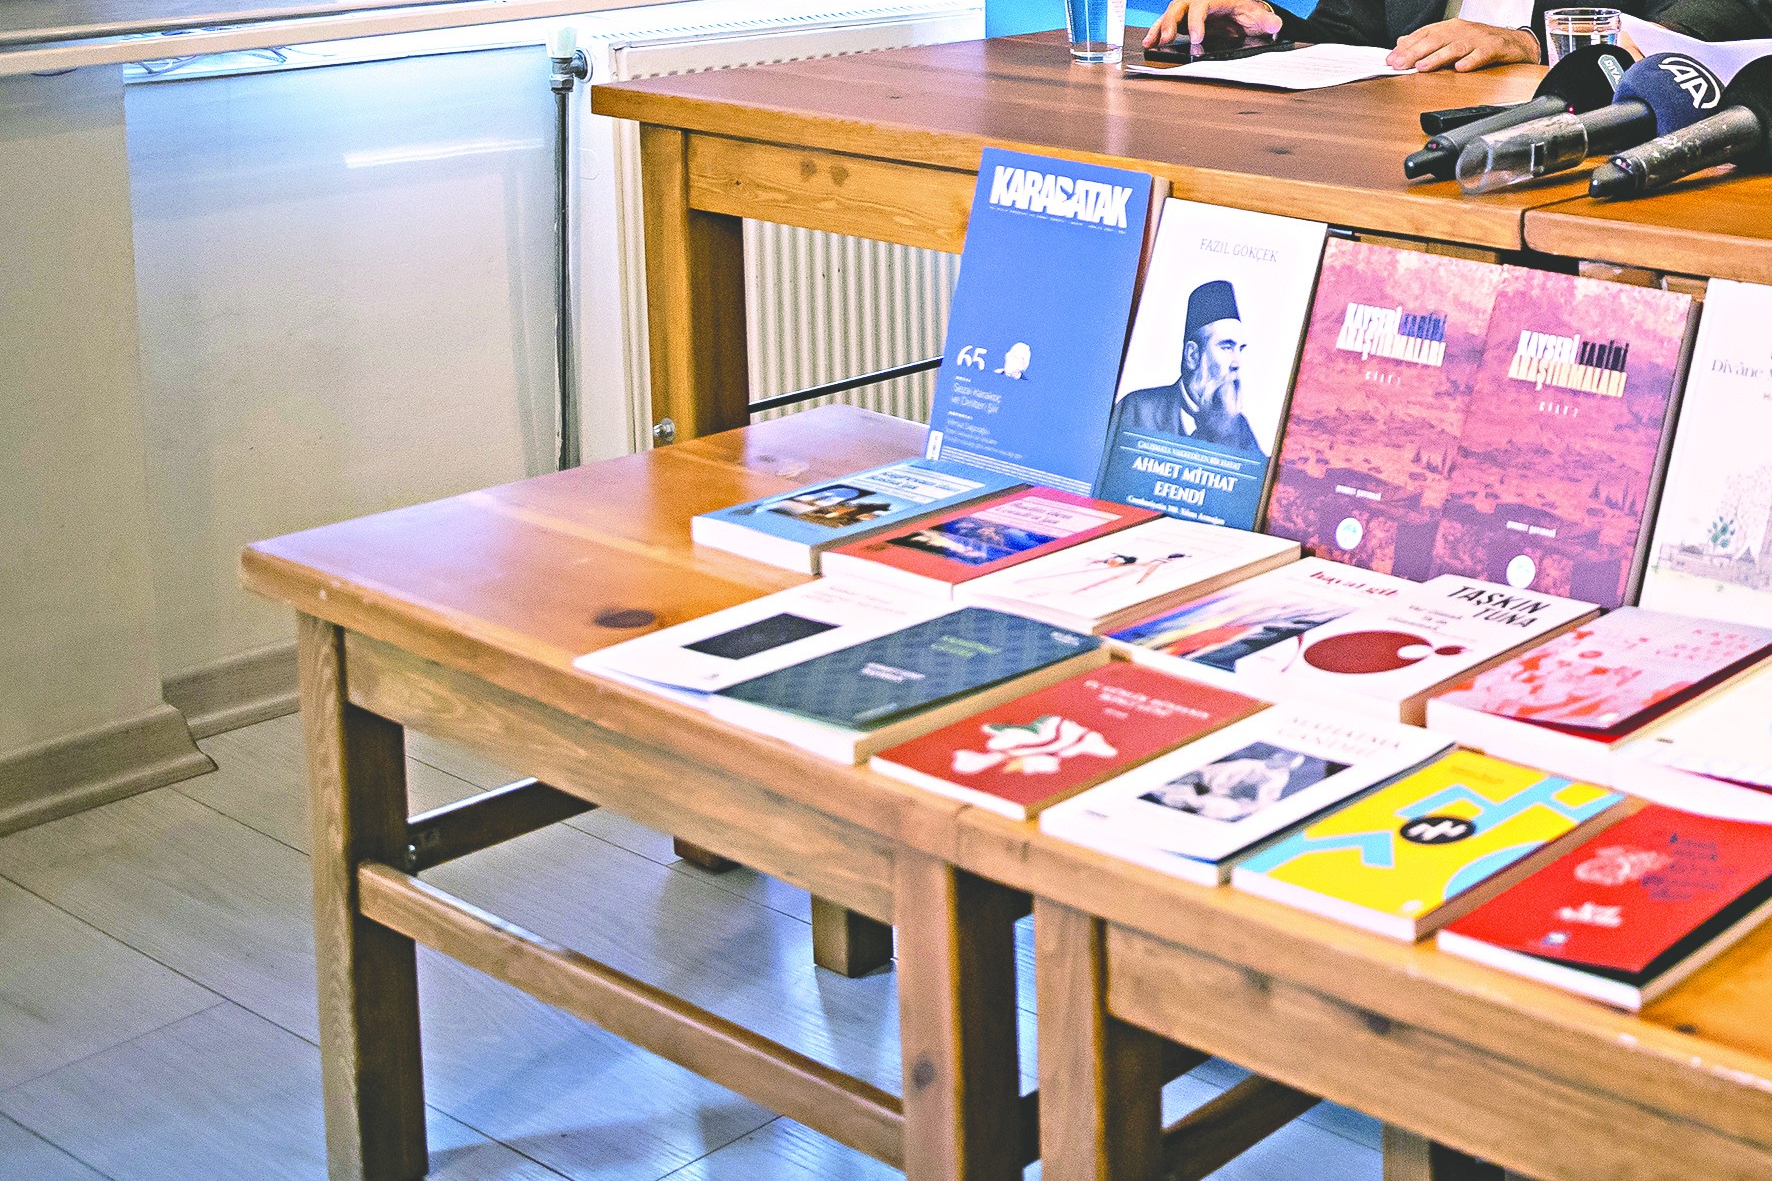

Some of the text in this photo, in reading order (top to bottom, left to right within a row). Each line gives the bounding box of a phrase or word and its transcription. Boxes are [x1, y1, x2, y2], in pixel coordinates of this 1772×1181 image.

[1658, 63, 1709, 109] AA
[989, 165, 1132, 228] KARABATAK
[956, 345, 988, 371] 65
[1516, 329, 1580, 365] KAYSERİ
[1133, 455, 1238, 492] AHMET MİTHAT
[1154, 480, 1206, 506] EFENDİ
[1448, 586, 1551, 615] TAŞKIN
[1473, 607, 1538, 628] TUNA
